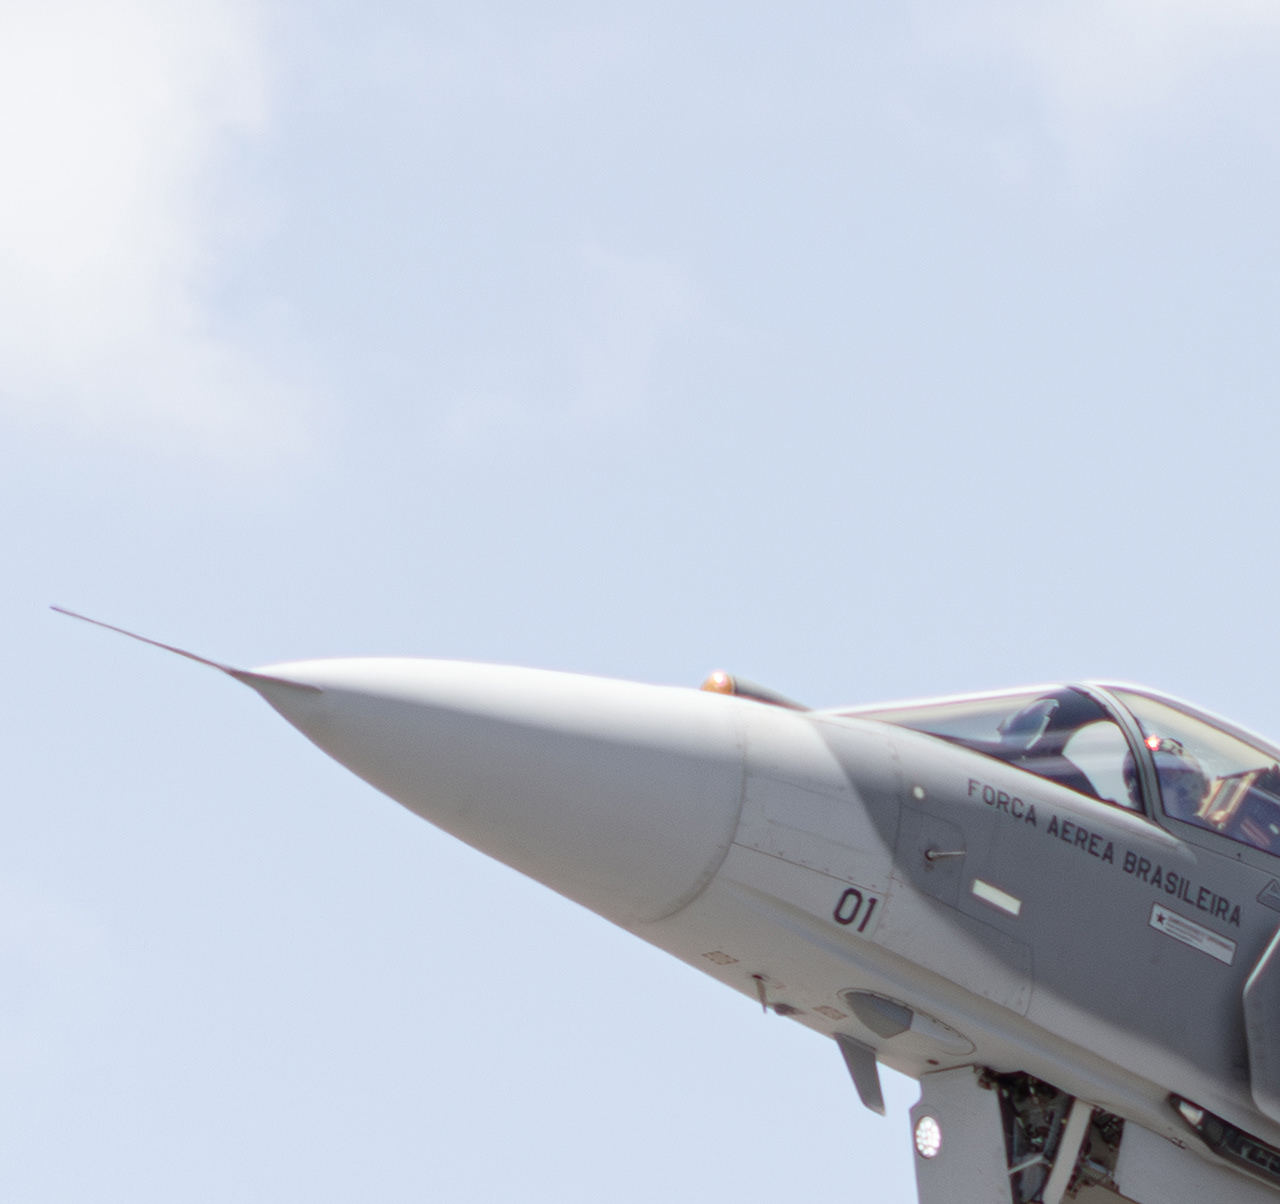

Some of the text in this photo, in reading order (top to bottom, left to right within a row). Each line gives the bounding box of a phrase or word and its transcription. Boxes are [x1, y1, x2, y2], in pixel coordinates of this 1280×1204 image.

[833, 887, 877, 933] 01
[1046, 814, 1114, 865] AEREA
[1122, 850, 1241, 928] BRASILEIRA
